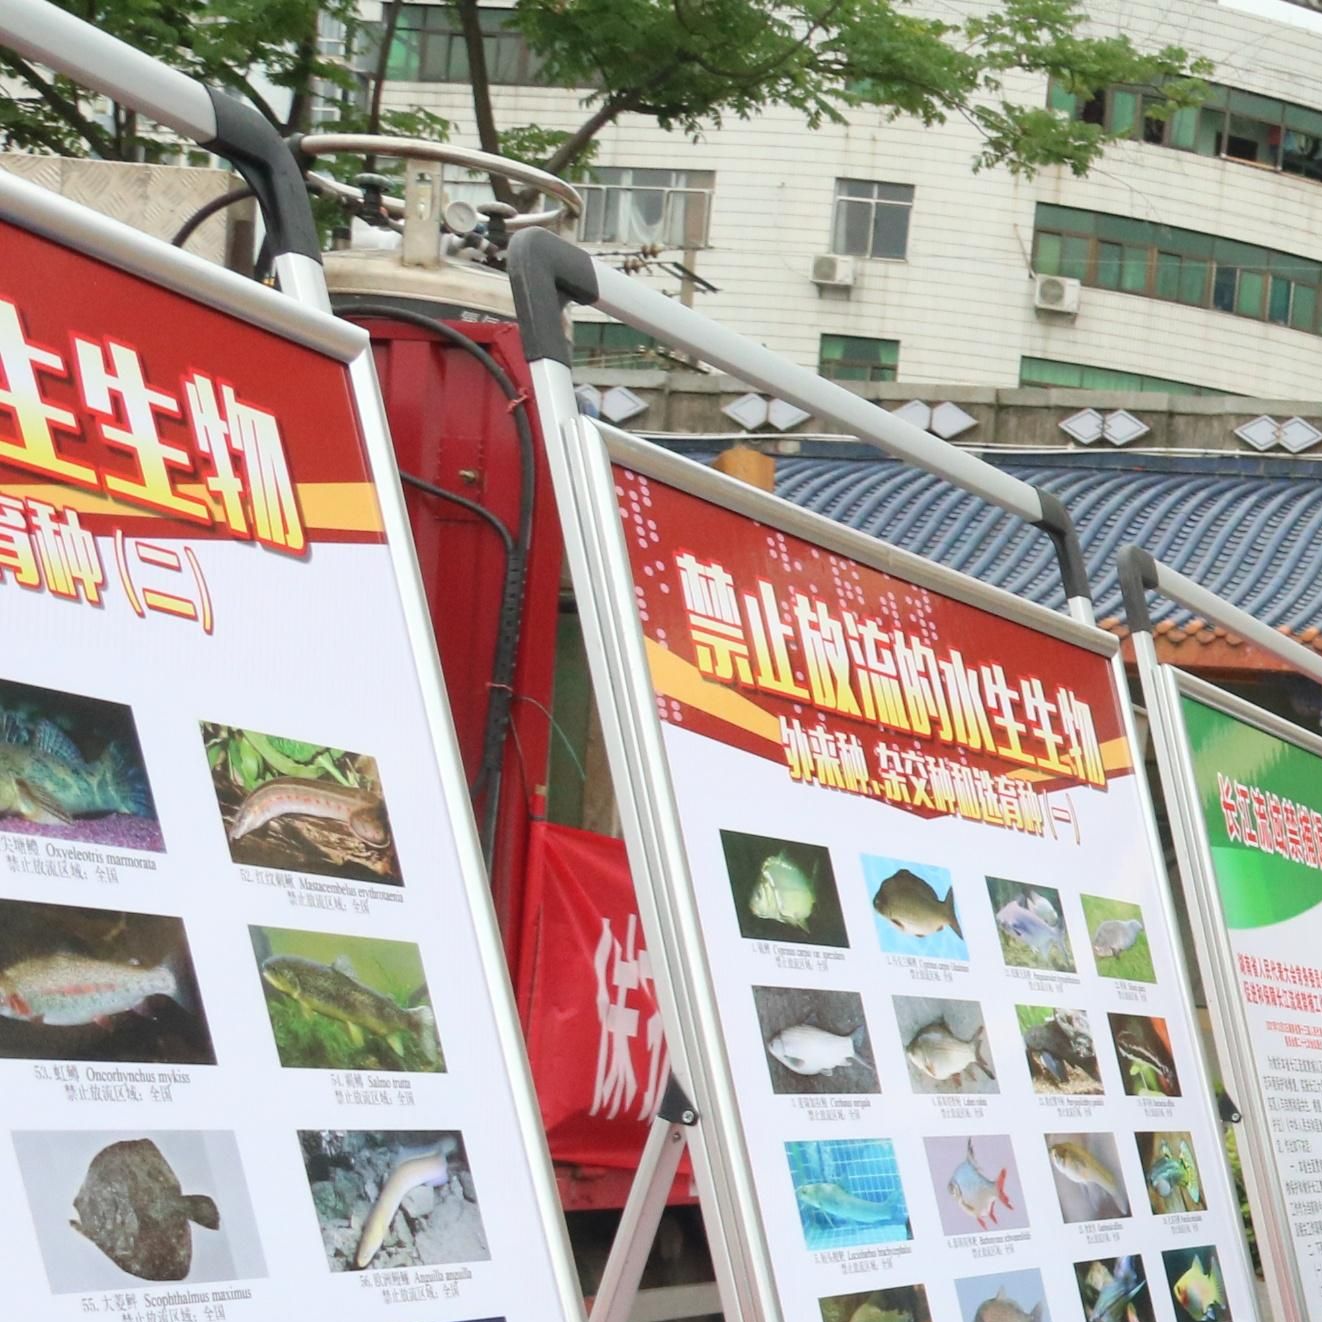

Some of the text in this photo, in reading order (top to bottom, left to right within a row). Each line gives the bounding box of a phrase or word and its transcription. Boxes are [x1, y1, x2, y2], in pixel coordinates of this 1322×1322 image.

[676, 548, 1106, 787] 禁止放流的水生生物
[143, 1290, 209, 1308] Scophthalmus
[211, 1287, 252, 1302] maximus
